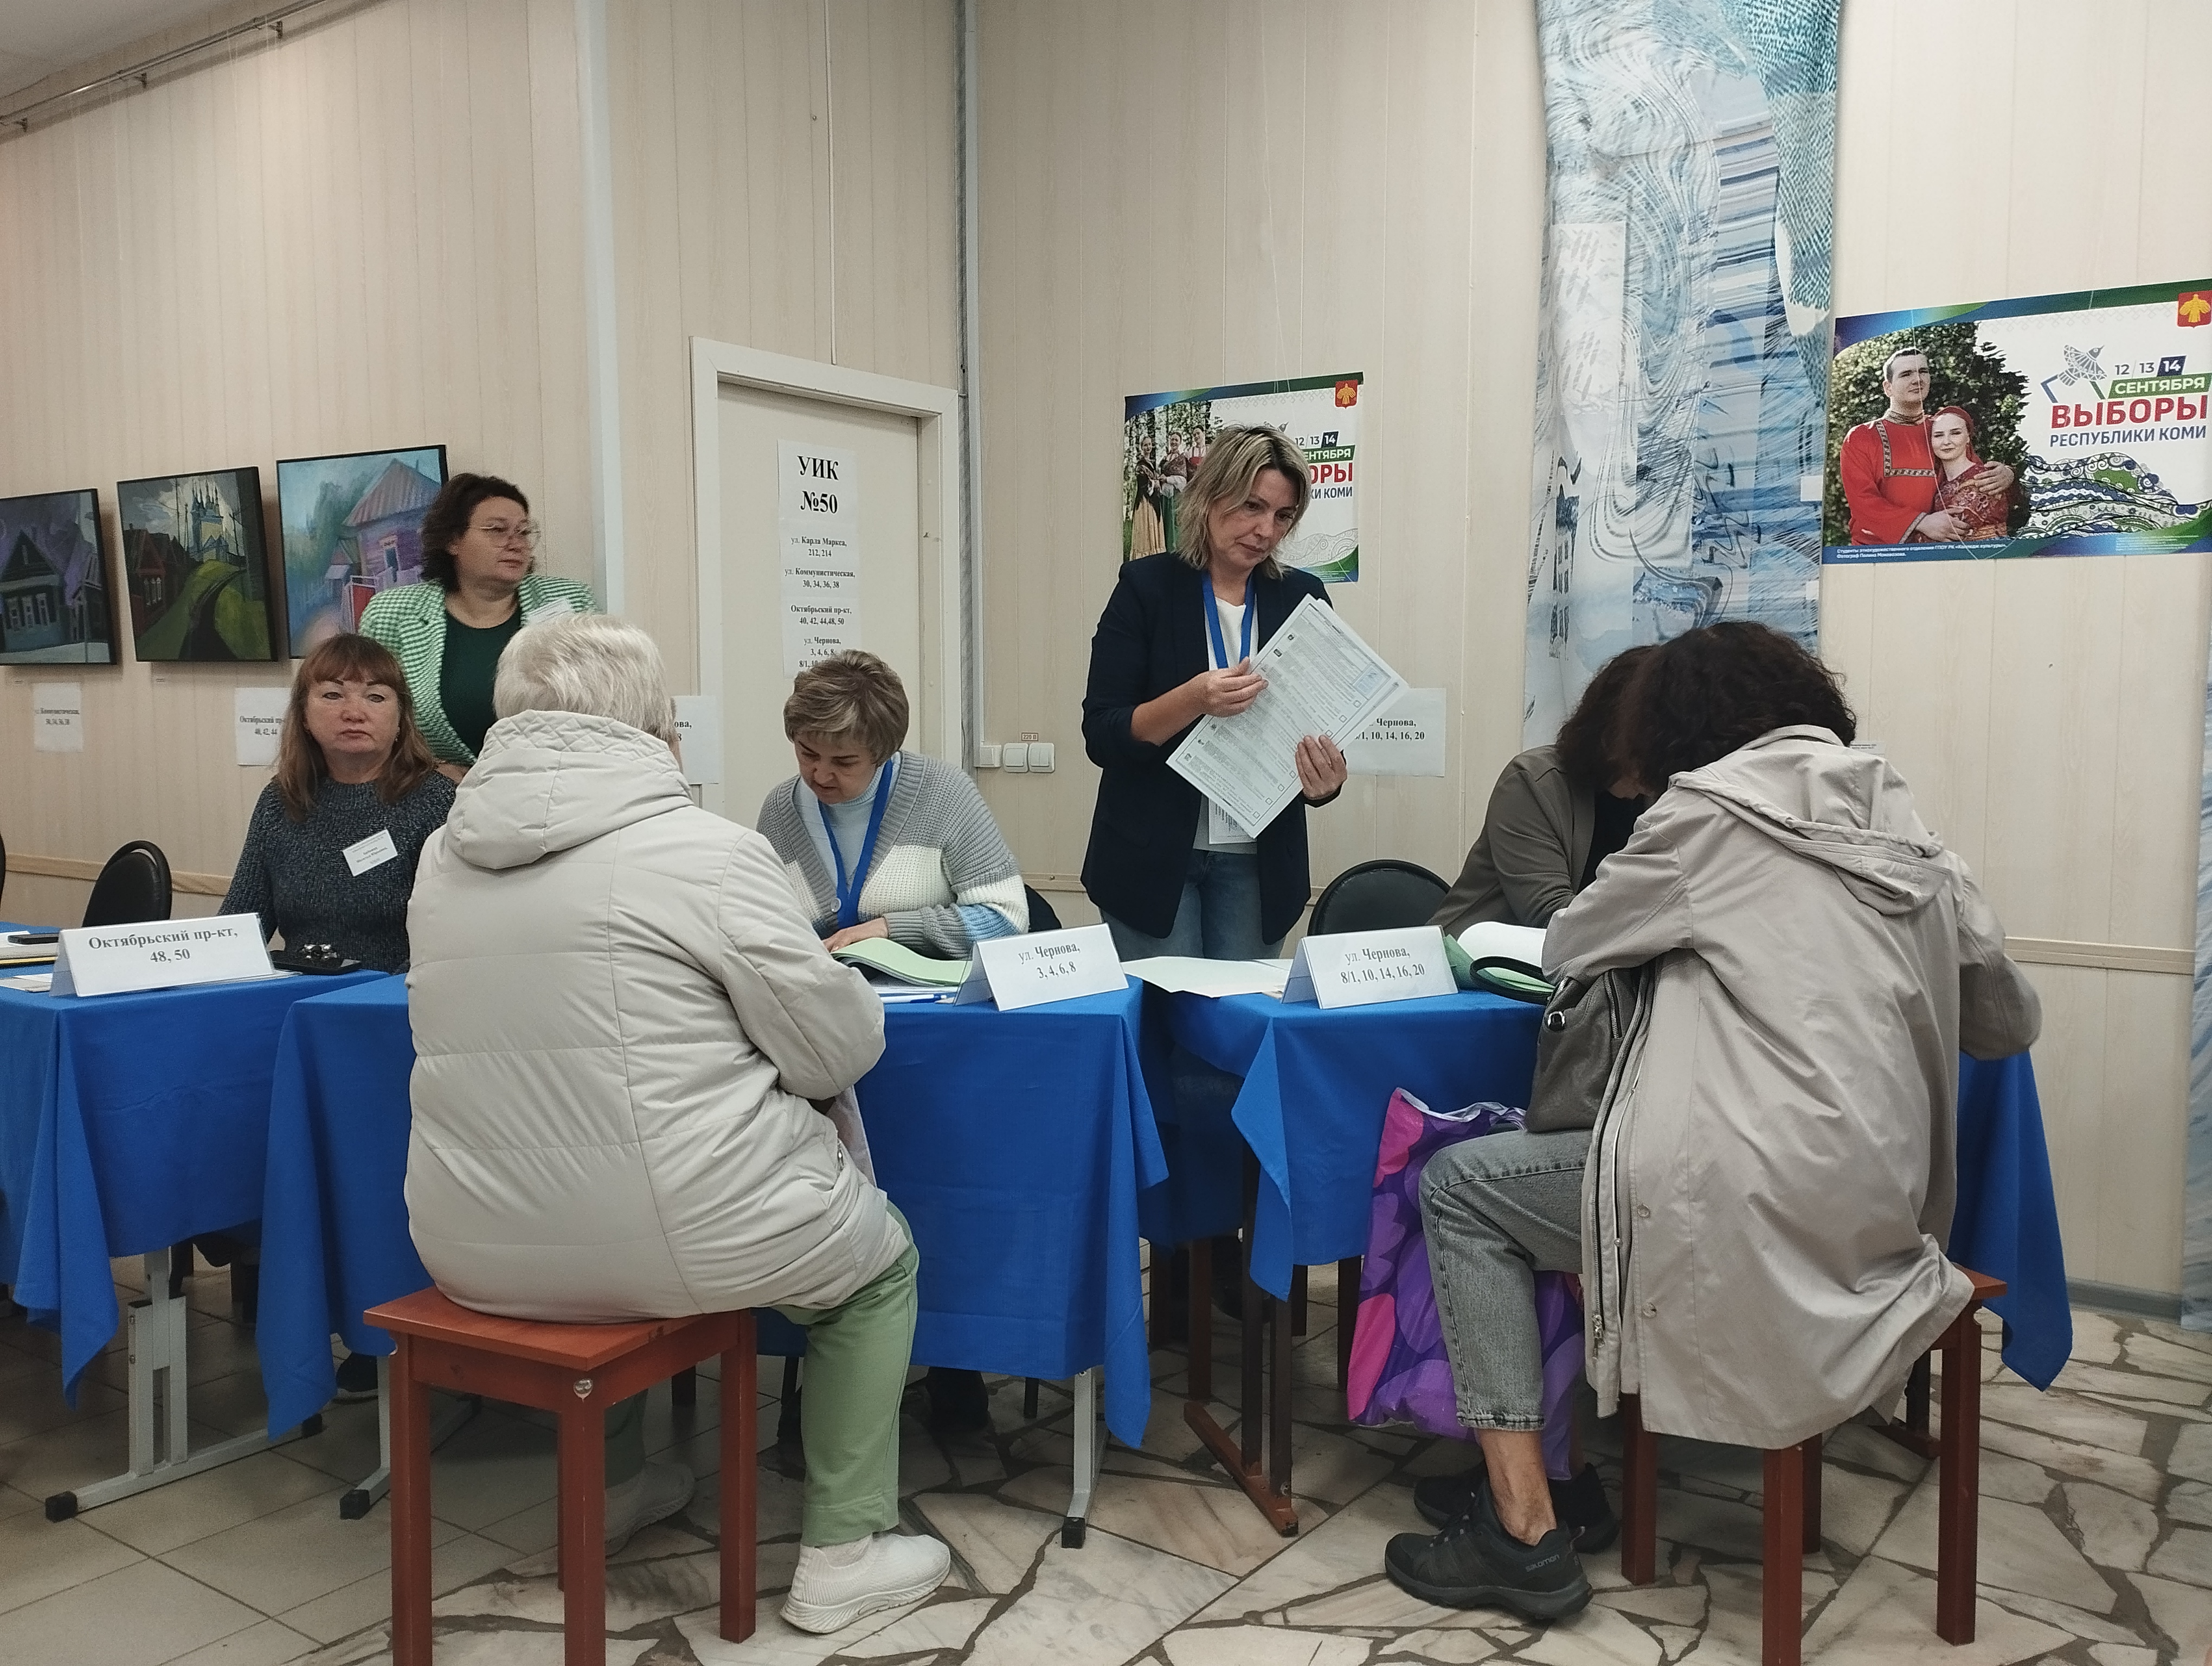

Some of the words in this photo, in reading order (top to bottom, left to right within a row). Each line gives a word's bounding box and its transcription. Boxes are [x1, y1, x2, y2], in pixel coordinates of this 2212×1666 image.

[2115, 364, 2130, 375] 12
[2139, 362, 2155, 373] 13
[2163, 360, 2181, 372] 14
[2115, 377, 2205, 394] СЕНТЯБРЯ
[2052, 395, 2208, 428] ВЫБОРЫ
[1295, 437, 1304, 445] 12
[1310, 436, 1320, 445] 13
[1324, 434, 1336, 444] 14
[2050, 428, 2155, 447] РЕСПУБЛИКИ
[2159, 425, 2207, 440] КОМИ
[1304, 448, 1351, 460] ЕНТЯБРЯ
[797, 456, 839, 480] УИК
[1309, 463, 1352, 484] ОРЫ
[1324, 486, 1352, 498] КОМИ
[800, 491, 838, 514] №50
[801, 536, 821, 546] Карла
[822, 537, 847, 547] Маркса,
[808, 549, 820, 557] 212,
[795, 568, 855, 579] Коммунистическая,
[791, 605, 832, 614] Октябрьский
[814, 637, 841, 645] Чернова,
[1377, 719, 1416, 728] Чернова,
[1371, 732, 1382, 741] 10,
[1386, 732, 1397, 741] 14,
[1400, 732, 1412, 741] 16,
[89, 931, 189, 949] Октябрьский
[194, 928, 237, 941] пр-кт,
[150, 951, 171, 963] 48,
[174, 949, 190, 960] 50
[1019, 952, 1033, 965] ул.
[1035, 944, 1080, 959] Чернова,
[1345, 953, 1360, 965] ул.
[1362, 949, 1410, 962] Чернова,
[1037, 967, 1047, 979] 3,
[1049, 965, 1059, 977] 4,
[1059, 963, 1069, 975] 6,
[1069, 962, 1076, 972] 8
[1340, 971, 1361, 984] 8/1,
[1362, 969, 1378, 982] 10,
[1380, 967, 1396, 979] 14,
[1397, 965, 1412, 978] 16,
[1412, 963, 1425, 975] 20
